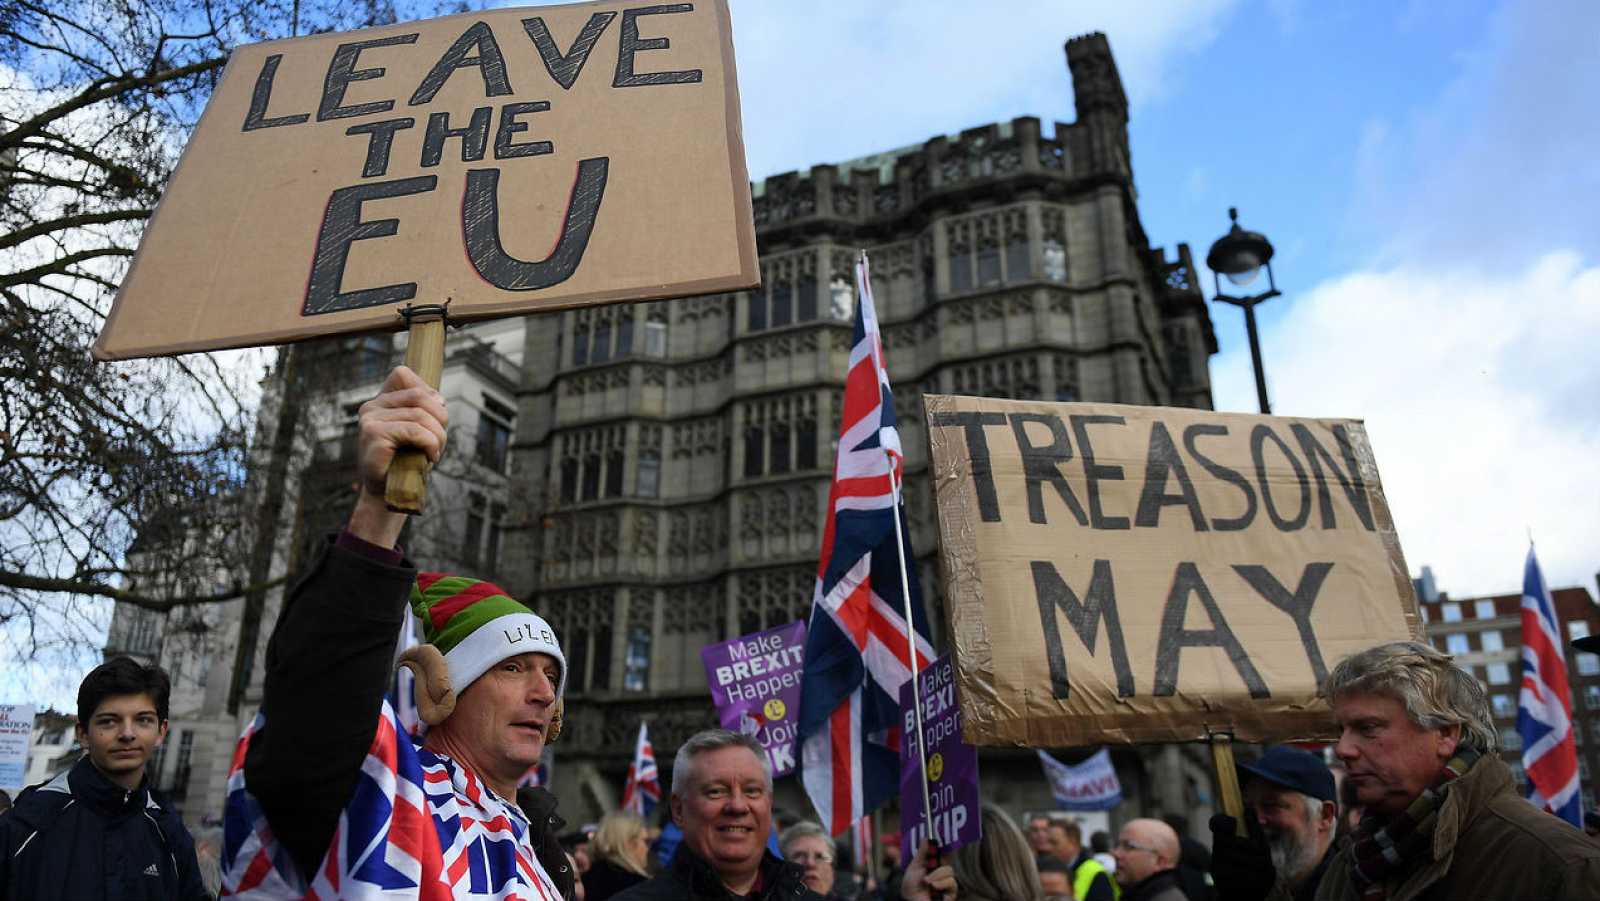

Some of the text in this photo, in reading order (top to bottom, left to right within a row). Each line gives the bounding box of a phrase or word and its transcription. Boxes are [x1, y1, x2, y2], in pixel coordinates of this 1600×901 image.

[242, 3, 703, 132] LEAVE
[345, 101, 555, 178] THE
[300, 156, 609, 316] EU
[933, 411, 1377, 532] TREASON
[716, 645, 803, 687] BREXIT
[727, 634, 784, 662] Make
[1030, 559, 1335, 700] MAY
